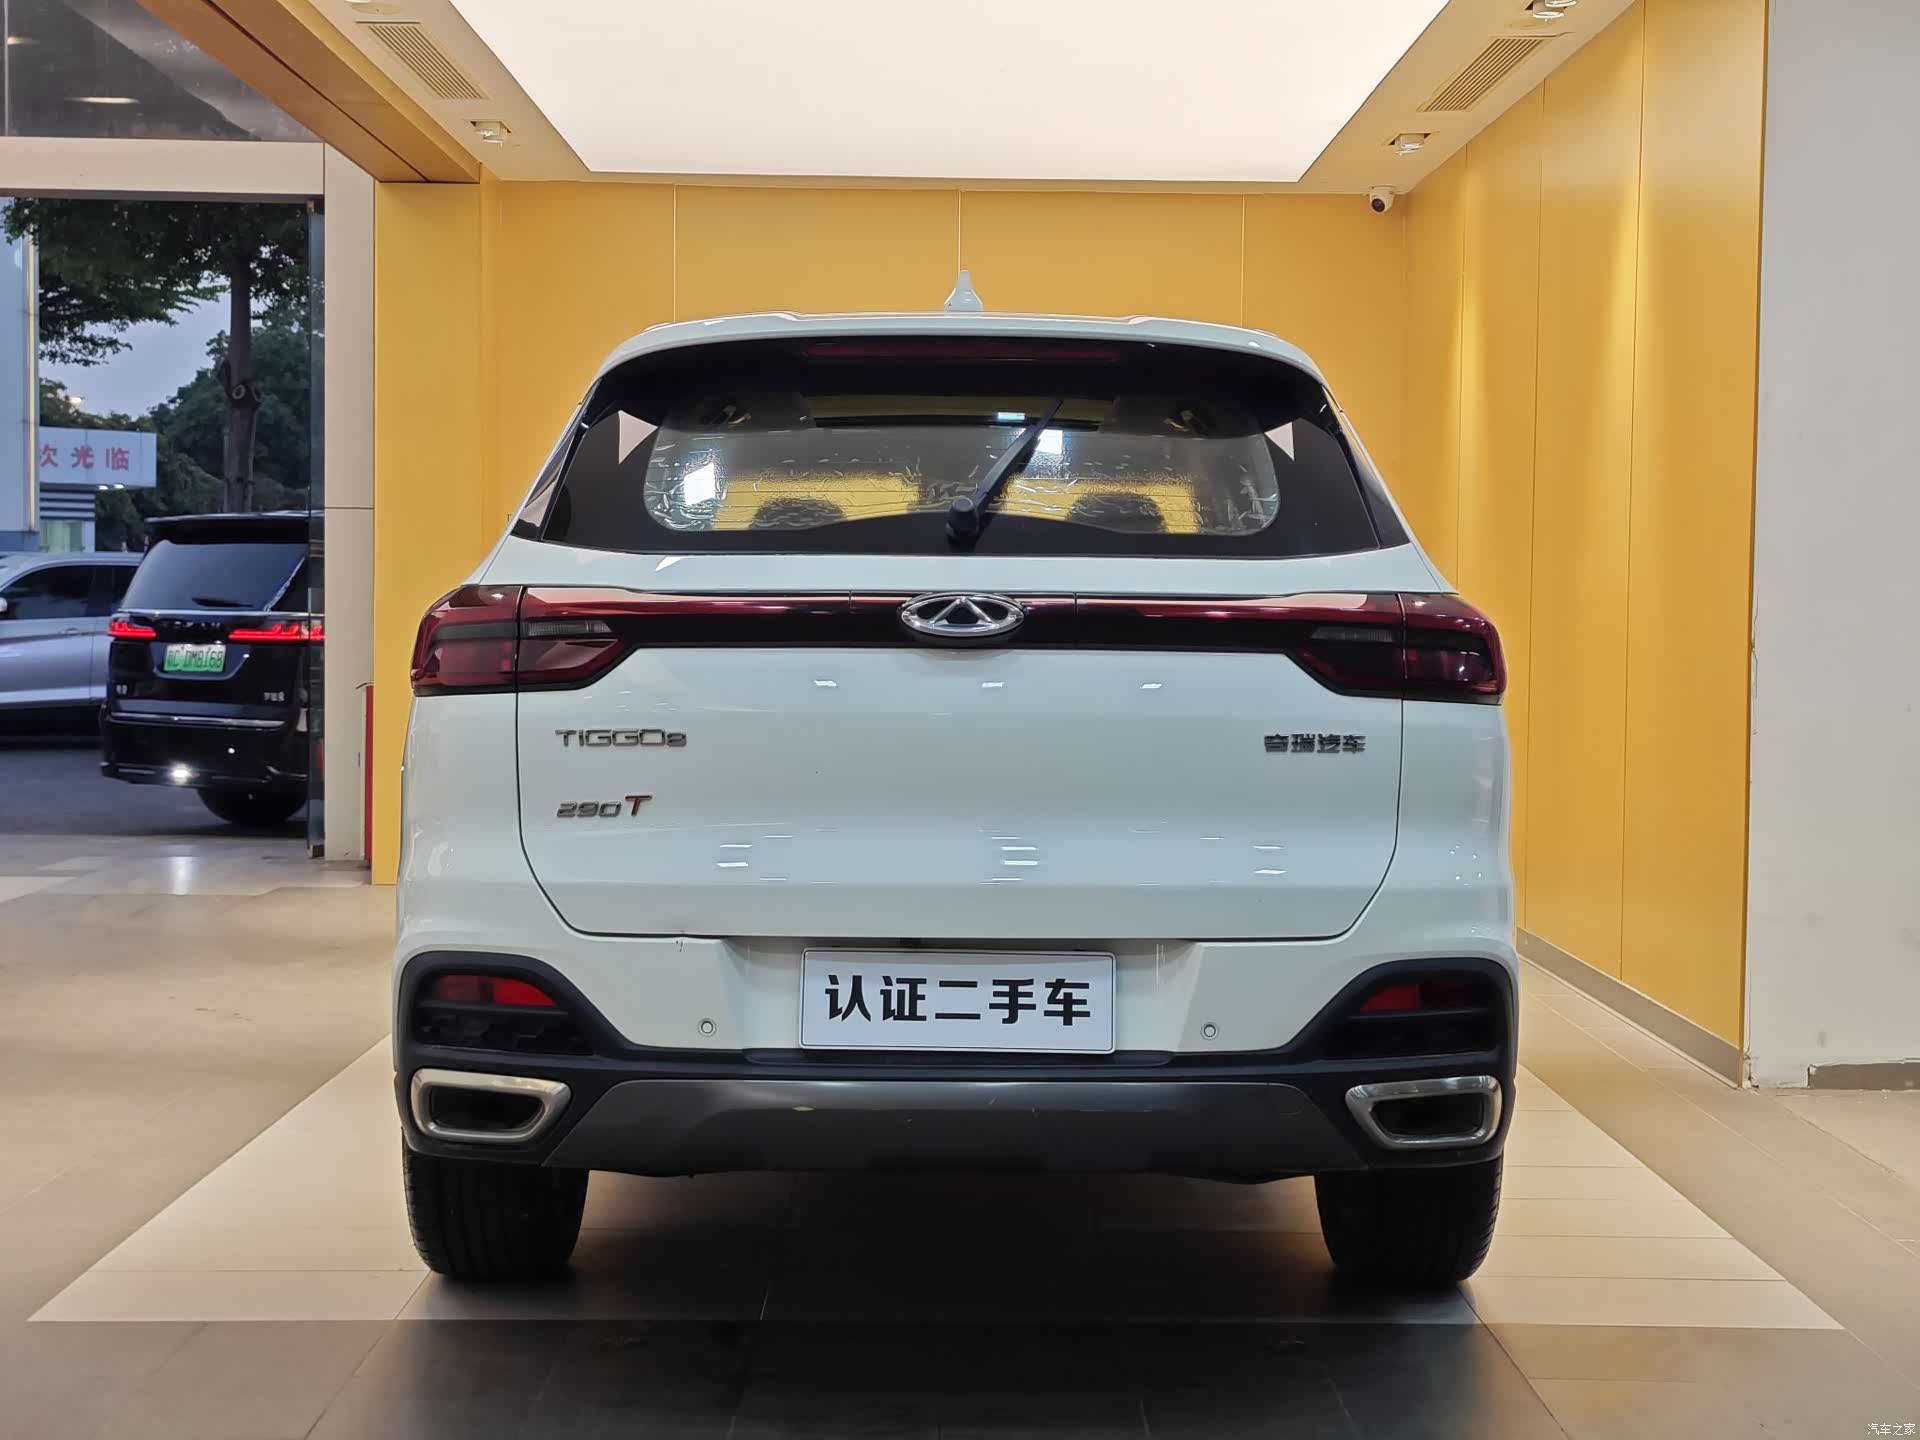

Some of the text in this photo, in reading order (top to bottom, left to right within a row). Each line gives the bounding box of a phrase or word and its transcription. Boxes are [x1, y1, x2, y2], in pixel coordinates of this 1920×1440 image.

[1264, 733, 1366, 753] 奇瑞汽车
[825, 974, 1091, 1026] 认证二手车
